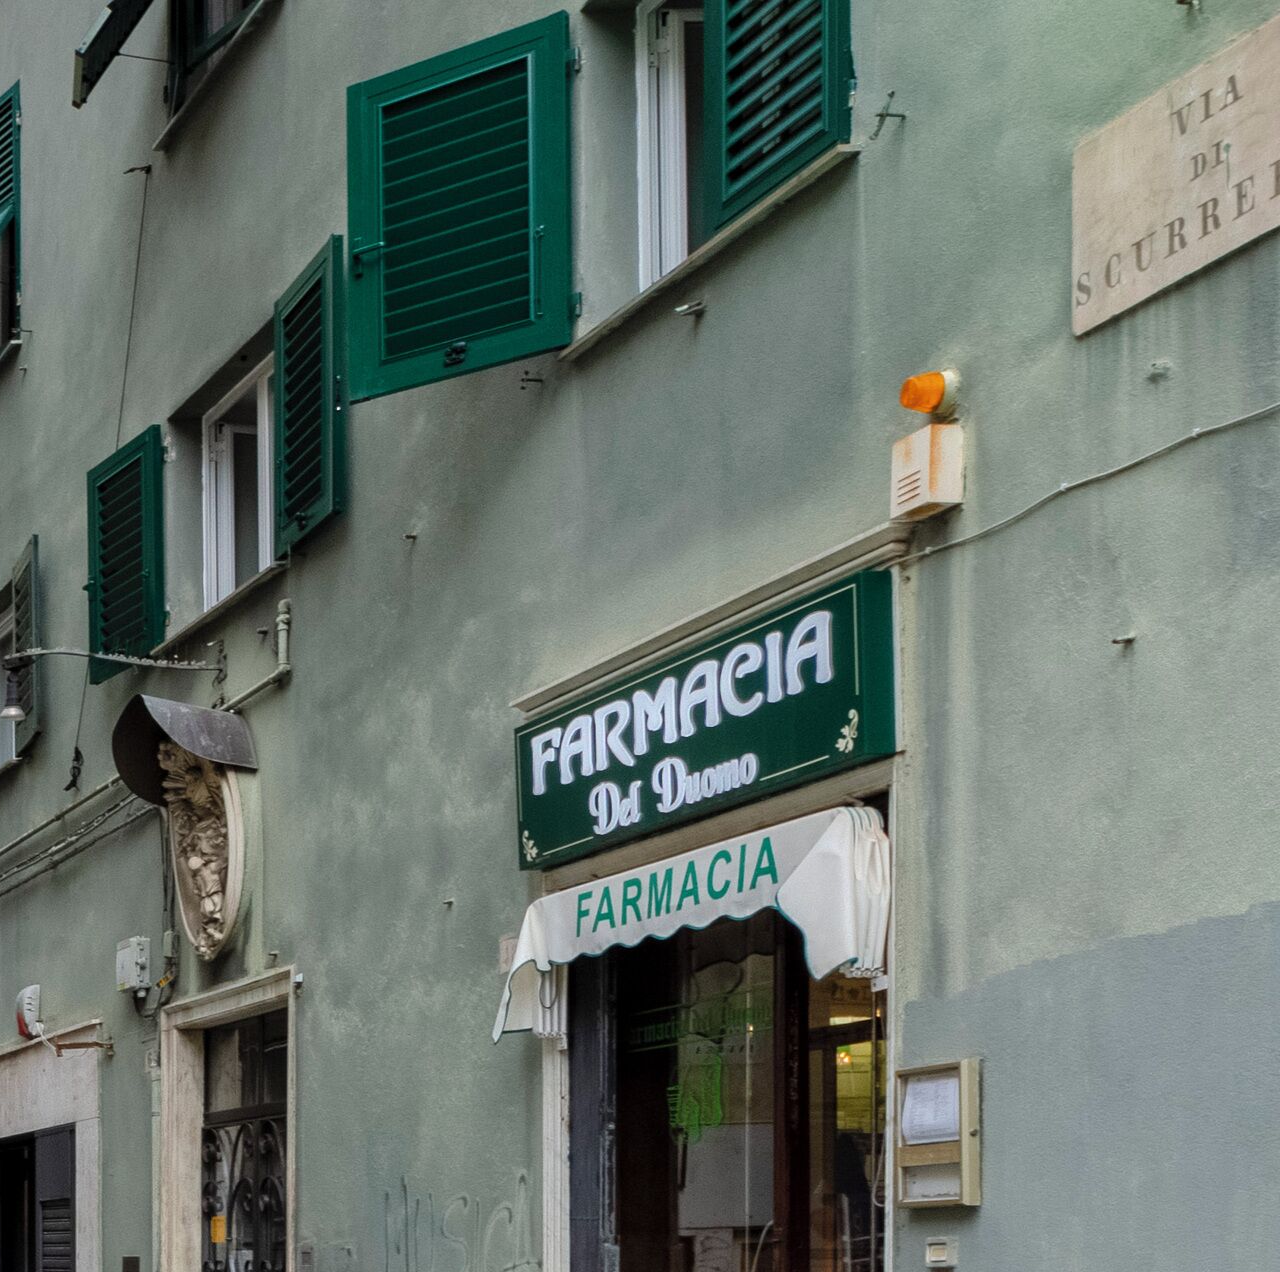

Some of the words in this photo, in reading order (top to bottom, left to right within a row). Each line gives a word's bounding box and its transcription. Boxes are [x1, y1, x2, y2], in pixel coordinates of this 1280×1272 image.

[1170, 74, 1244, 136] VIA
[1190, 139, 1225, 182] DI
[530, 610, 834, 796] FARMACIA
[589, 780, 643, 836] Del
[652, 752, 758, 814] Duomo
[575, 836, 779, 938] FARMACIA
